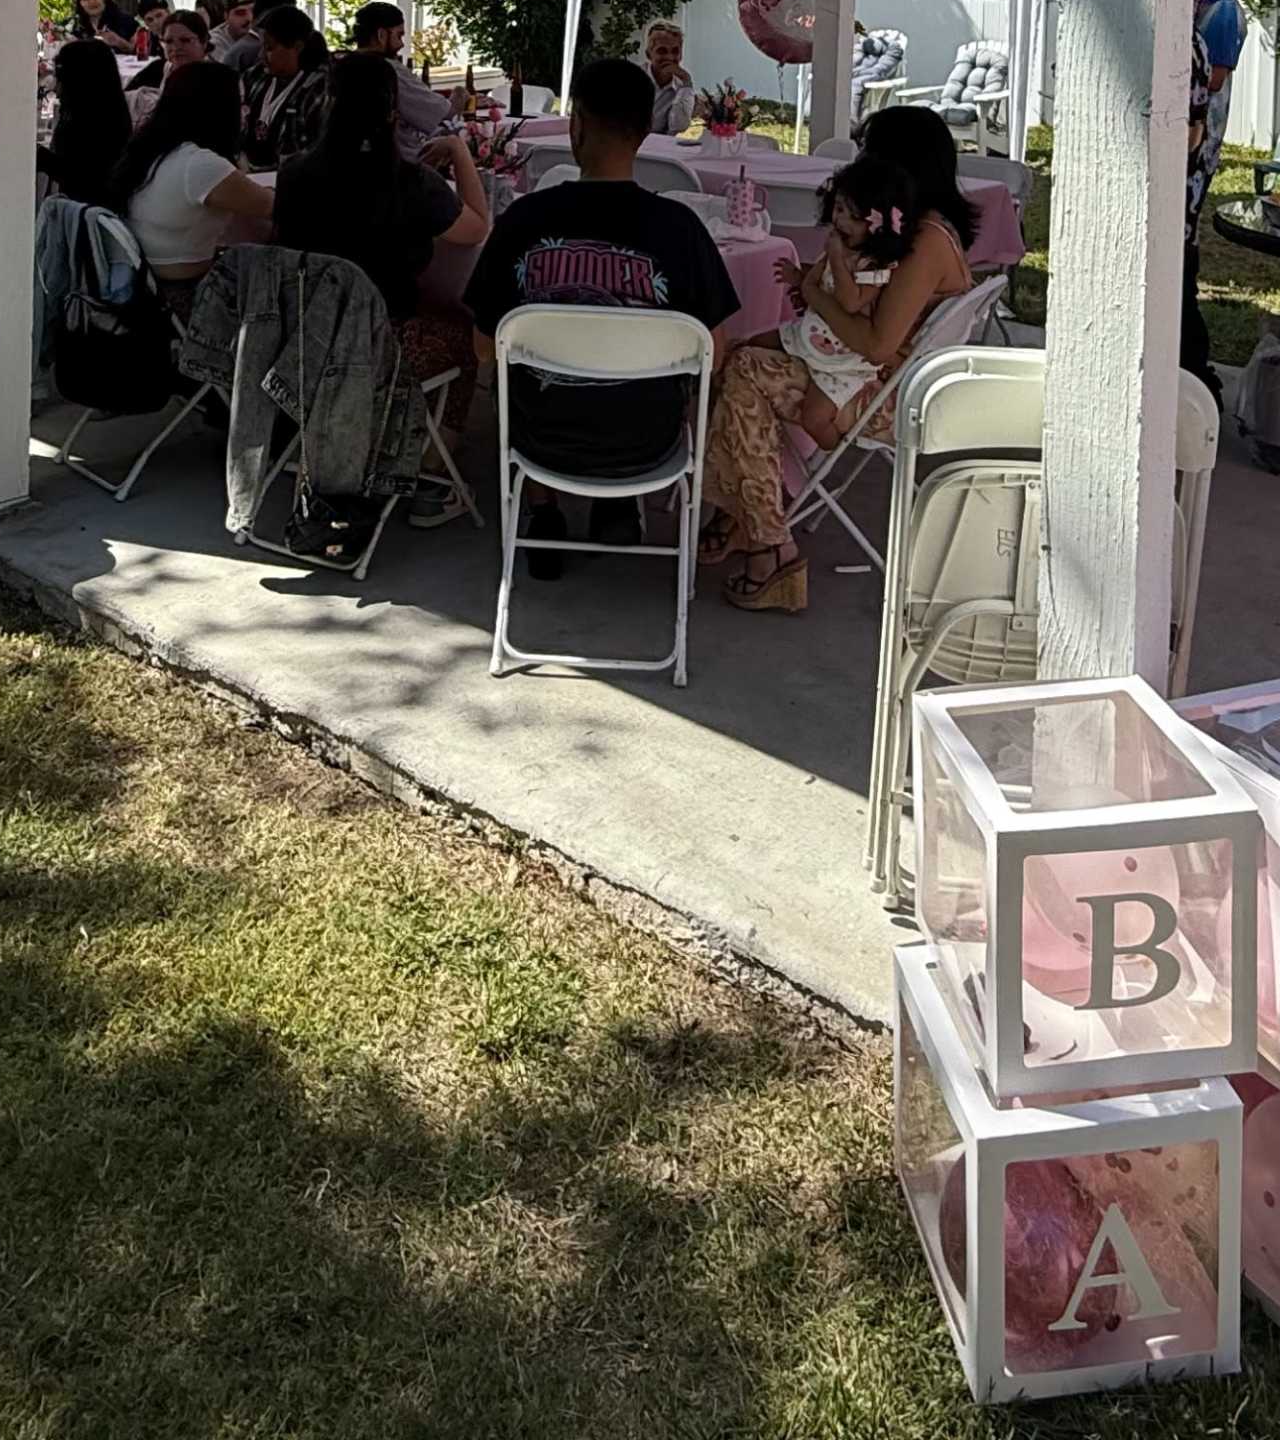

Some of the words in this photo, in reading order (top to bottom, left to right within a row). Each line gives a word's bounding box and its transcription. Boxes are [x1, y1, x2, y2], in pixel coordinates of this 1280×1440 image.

[527, 247, 657, 307] SUMMER
[1074, 892, 1182, 1011] B
[1048, 1203, 1181, 1332] A
